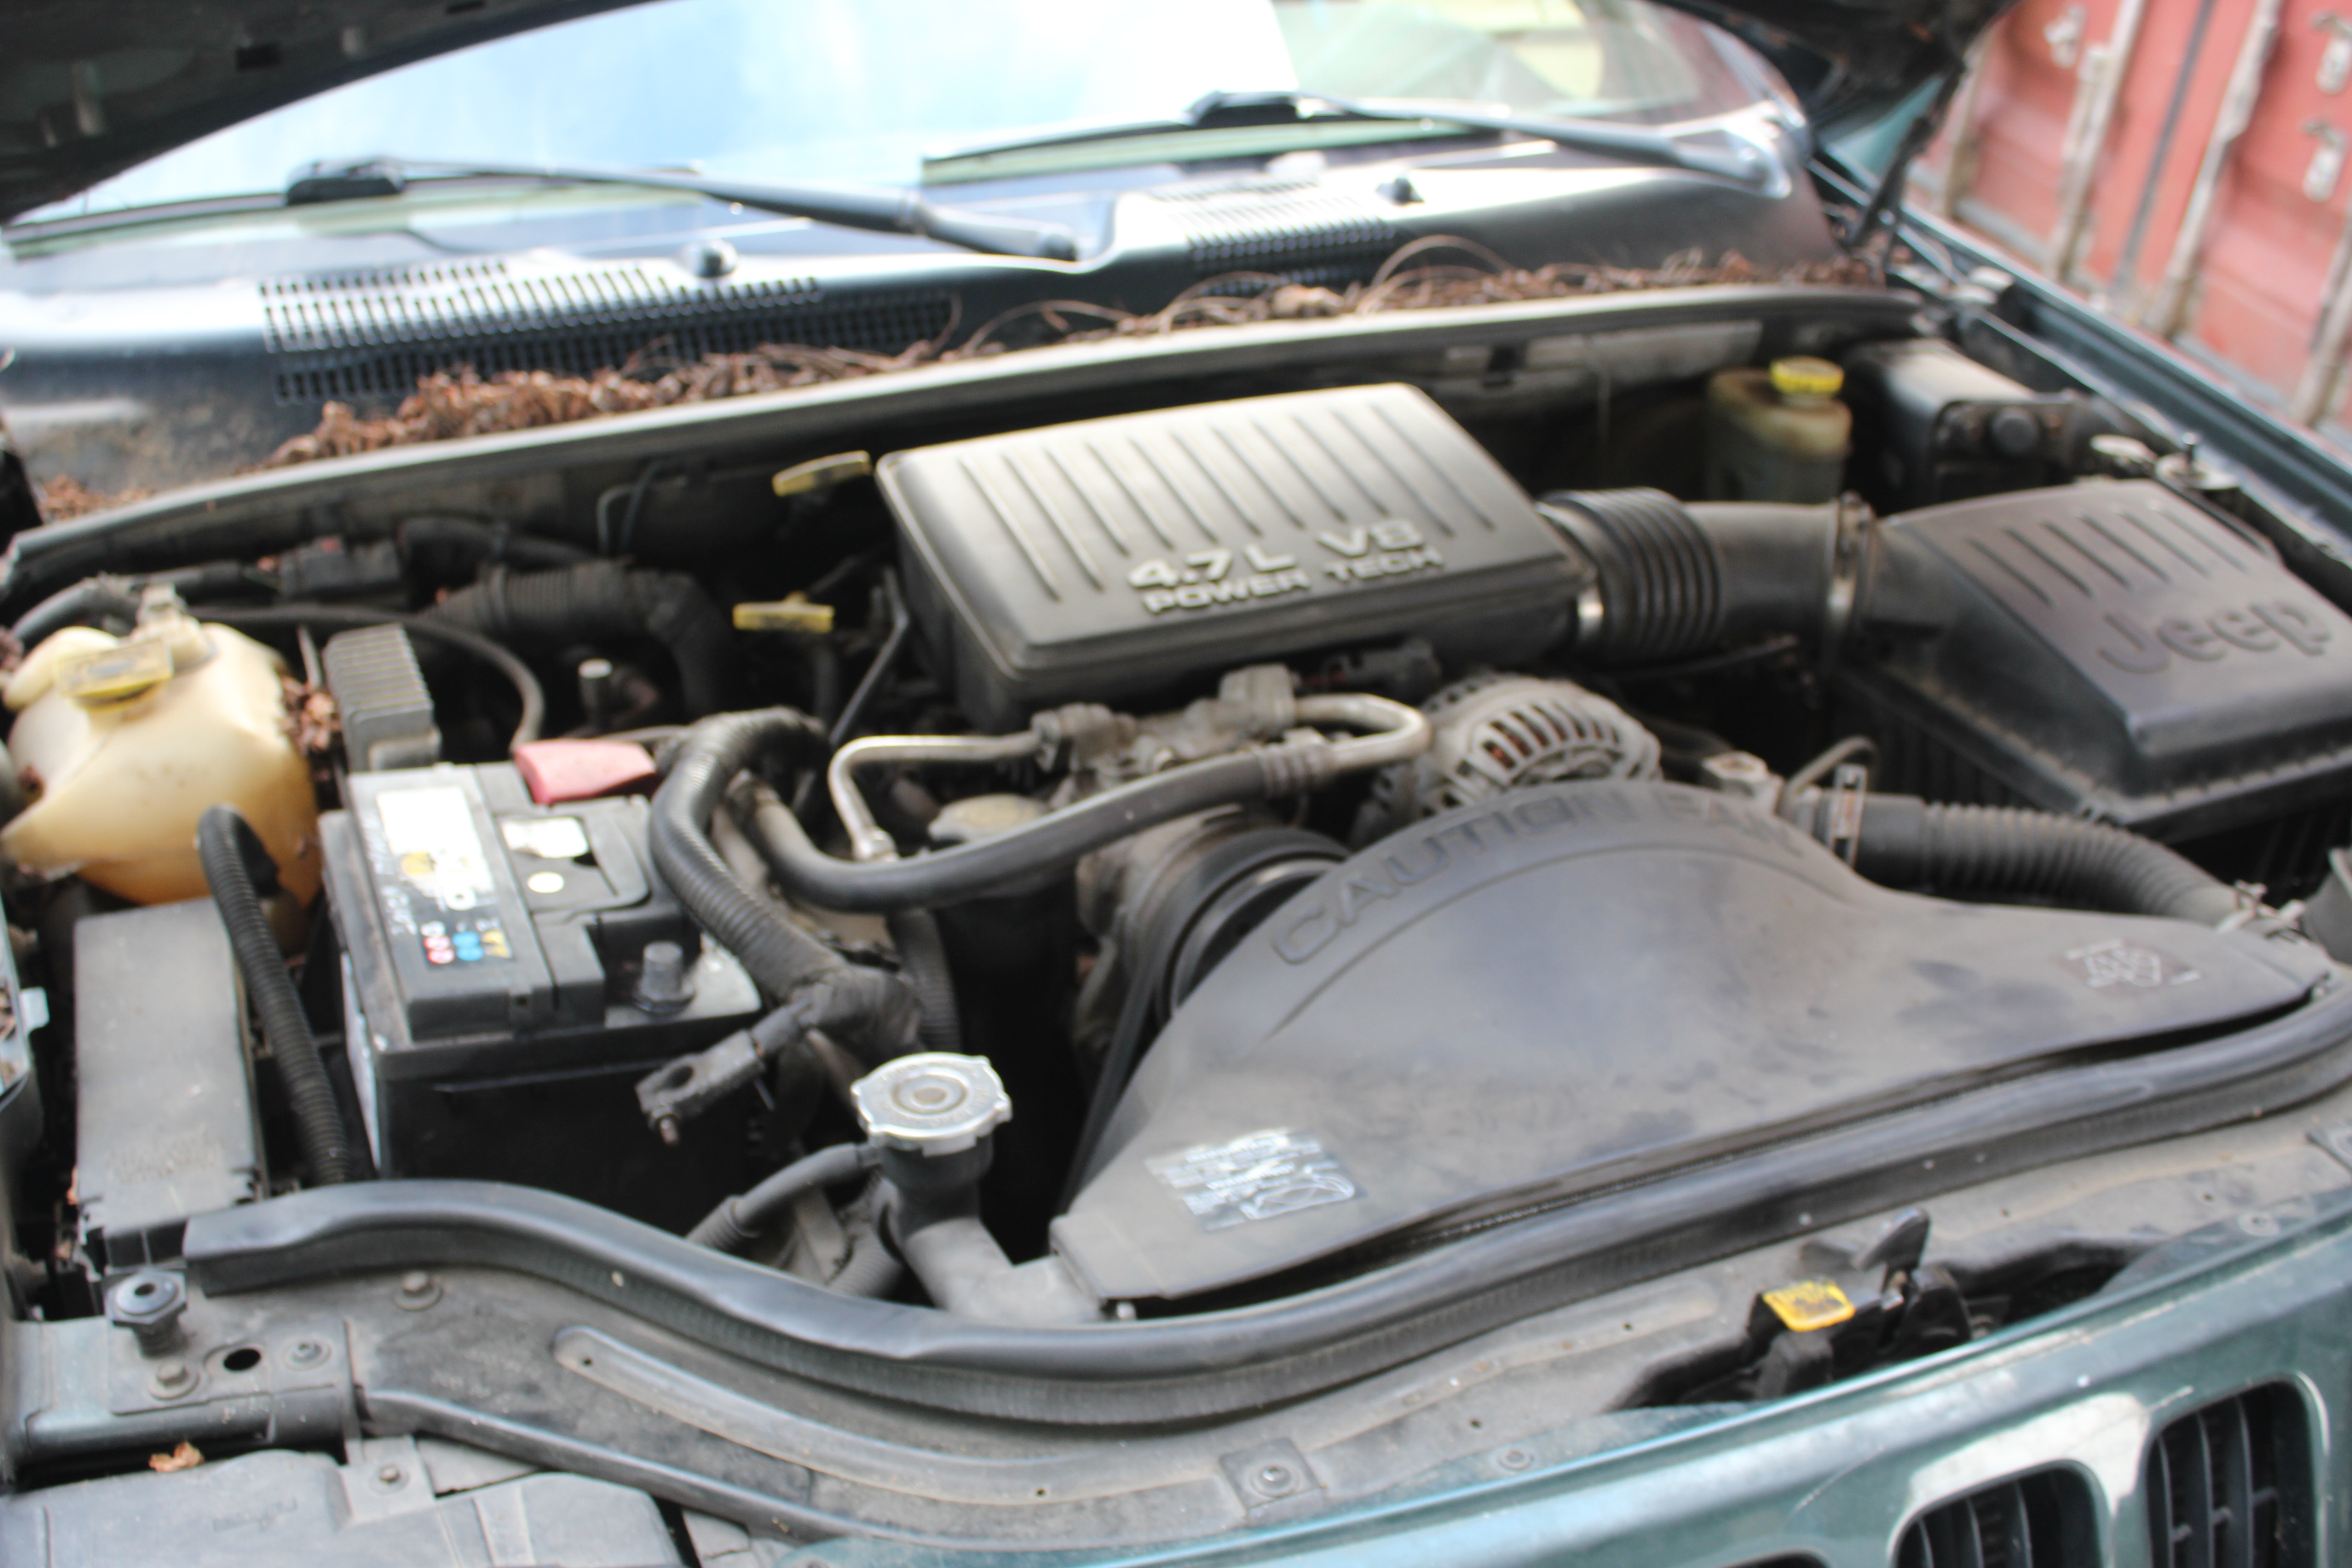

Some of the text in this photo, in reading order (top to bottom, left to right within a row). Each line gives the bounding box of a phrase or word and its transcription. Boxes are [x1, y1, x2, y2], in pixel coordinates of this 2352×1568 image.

[1316, 519, 1426, 557] V8
[1143, 547, 1444, 614] POWER TECH
[2098, 601, 2333, 674] Jeep
[1270, 792, 1639, 965] CAUTION
